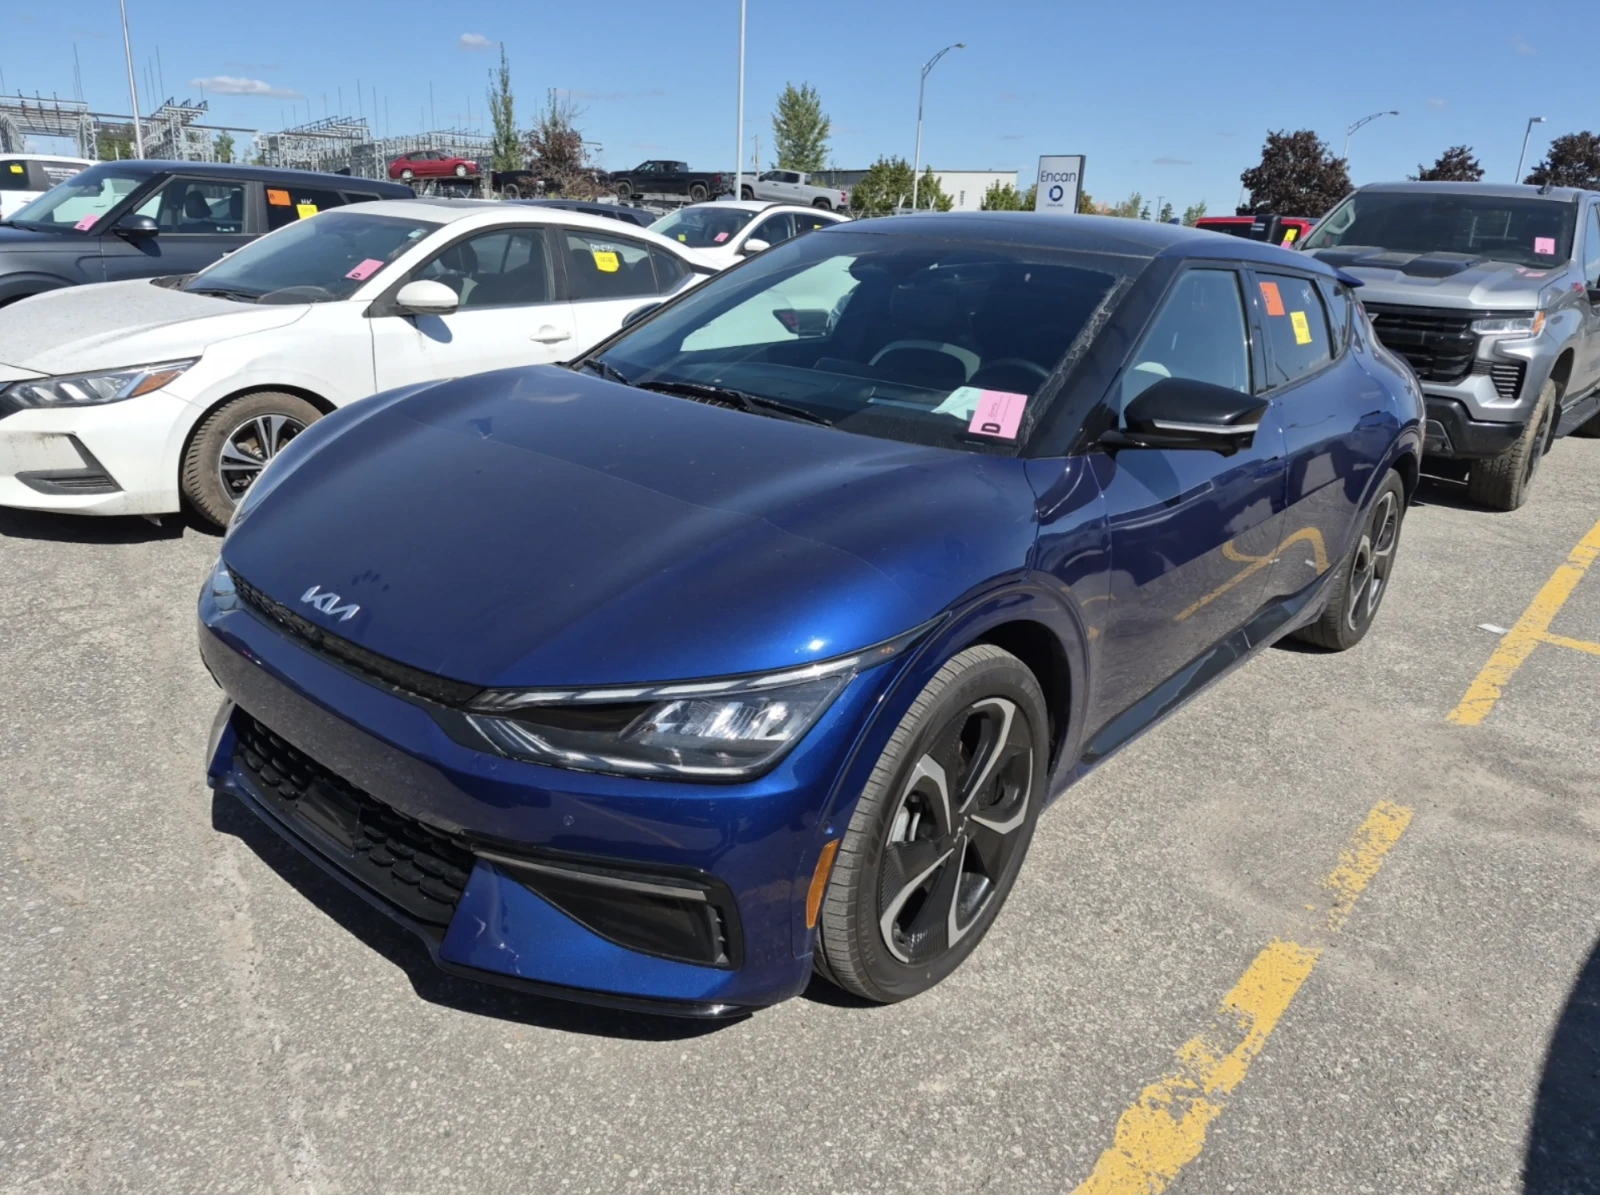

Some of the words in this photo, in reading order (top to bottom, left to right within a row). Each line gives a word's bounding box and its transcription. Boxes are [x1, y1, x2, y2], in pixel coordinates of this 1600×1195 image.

[1040, 170, 1077, 182] Encan
[980, 422, 1002, 434] D
[300, 585, 361, 622] KIA
